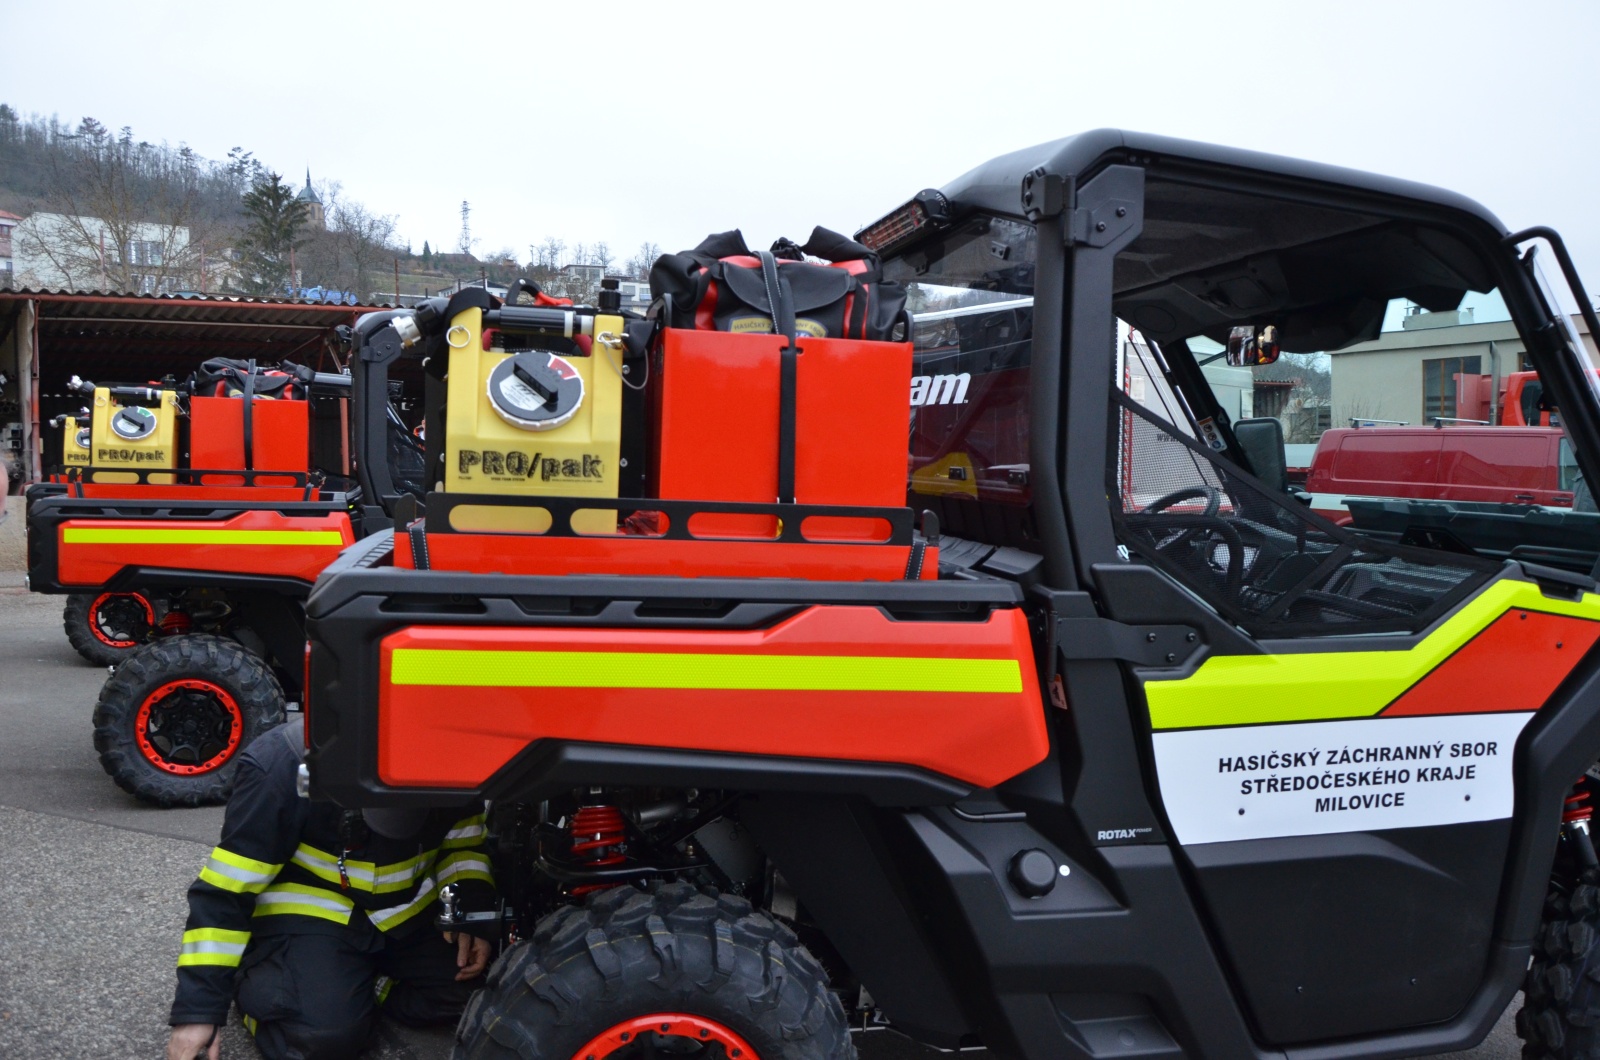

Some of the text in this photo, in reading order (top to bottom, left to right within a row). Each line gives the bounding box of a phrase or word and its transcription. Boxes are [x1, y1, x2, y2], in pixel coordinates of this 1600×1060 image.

[98, 449, 165, 463] PRO/pak
[458, 449, 603, 482] PRO/pak
[1218, 740, 1498, 774] HASIČSKÝ ZÁCHRANNÝ SBOR
[1240, 764, 1477, 795] STŘEDOČESKÉHO KRAJE
[1314, 791, 1406, 813] MILOVICE
[1098, 828, 1137, 841] ROTAX
